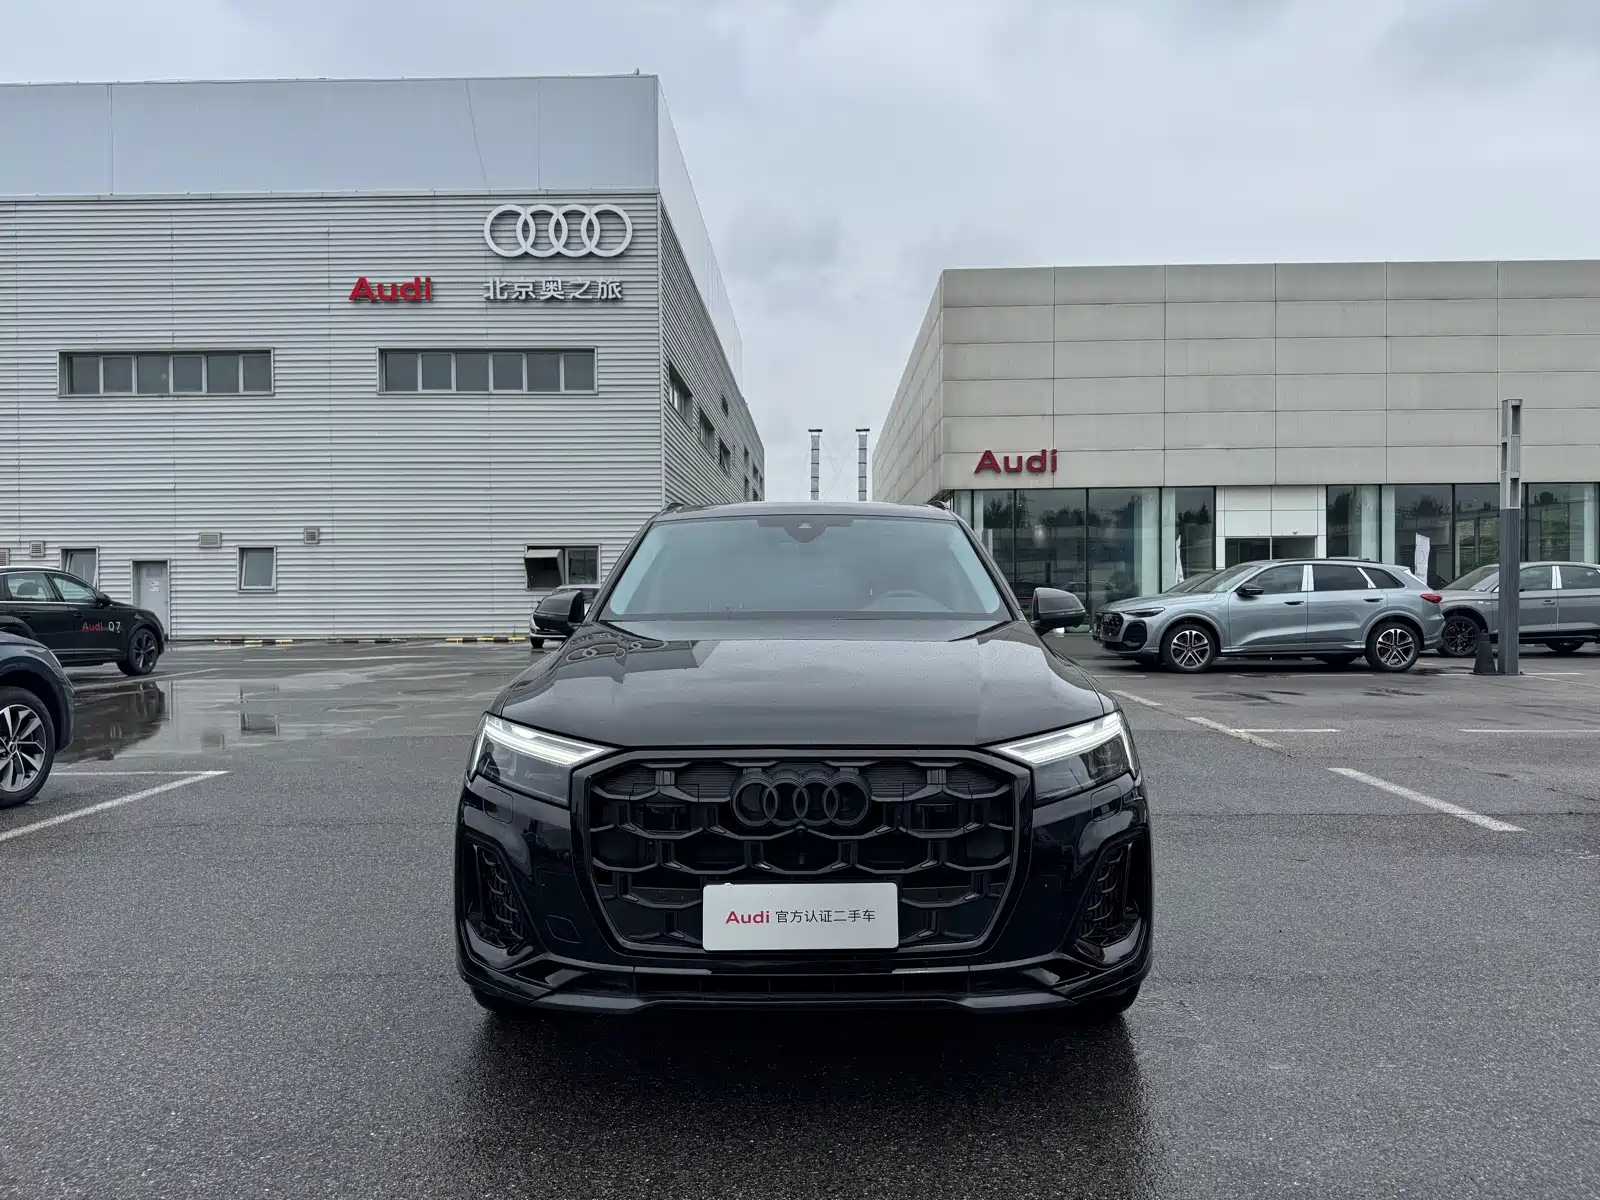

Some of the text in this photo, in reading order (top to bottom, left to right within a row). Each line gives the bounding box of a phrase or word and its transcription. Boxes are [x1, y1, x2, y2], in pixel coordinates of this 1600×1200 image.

[349, 277, 432, 302] Audi
[483, 277, 622, 300] 北京奥之旅
[974, 449, 1058, 473] Audi
[82, 622, 104, 632] Audi
[725, 909, 876, 924] Audi 官方认证二手车
